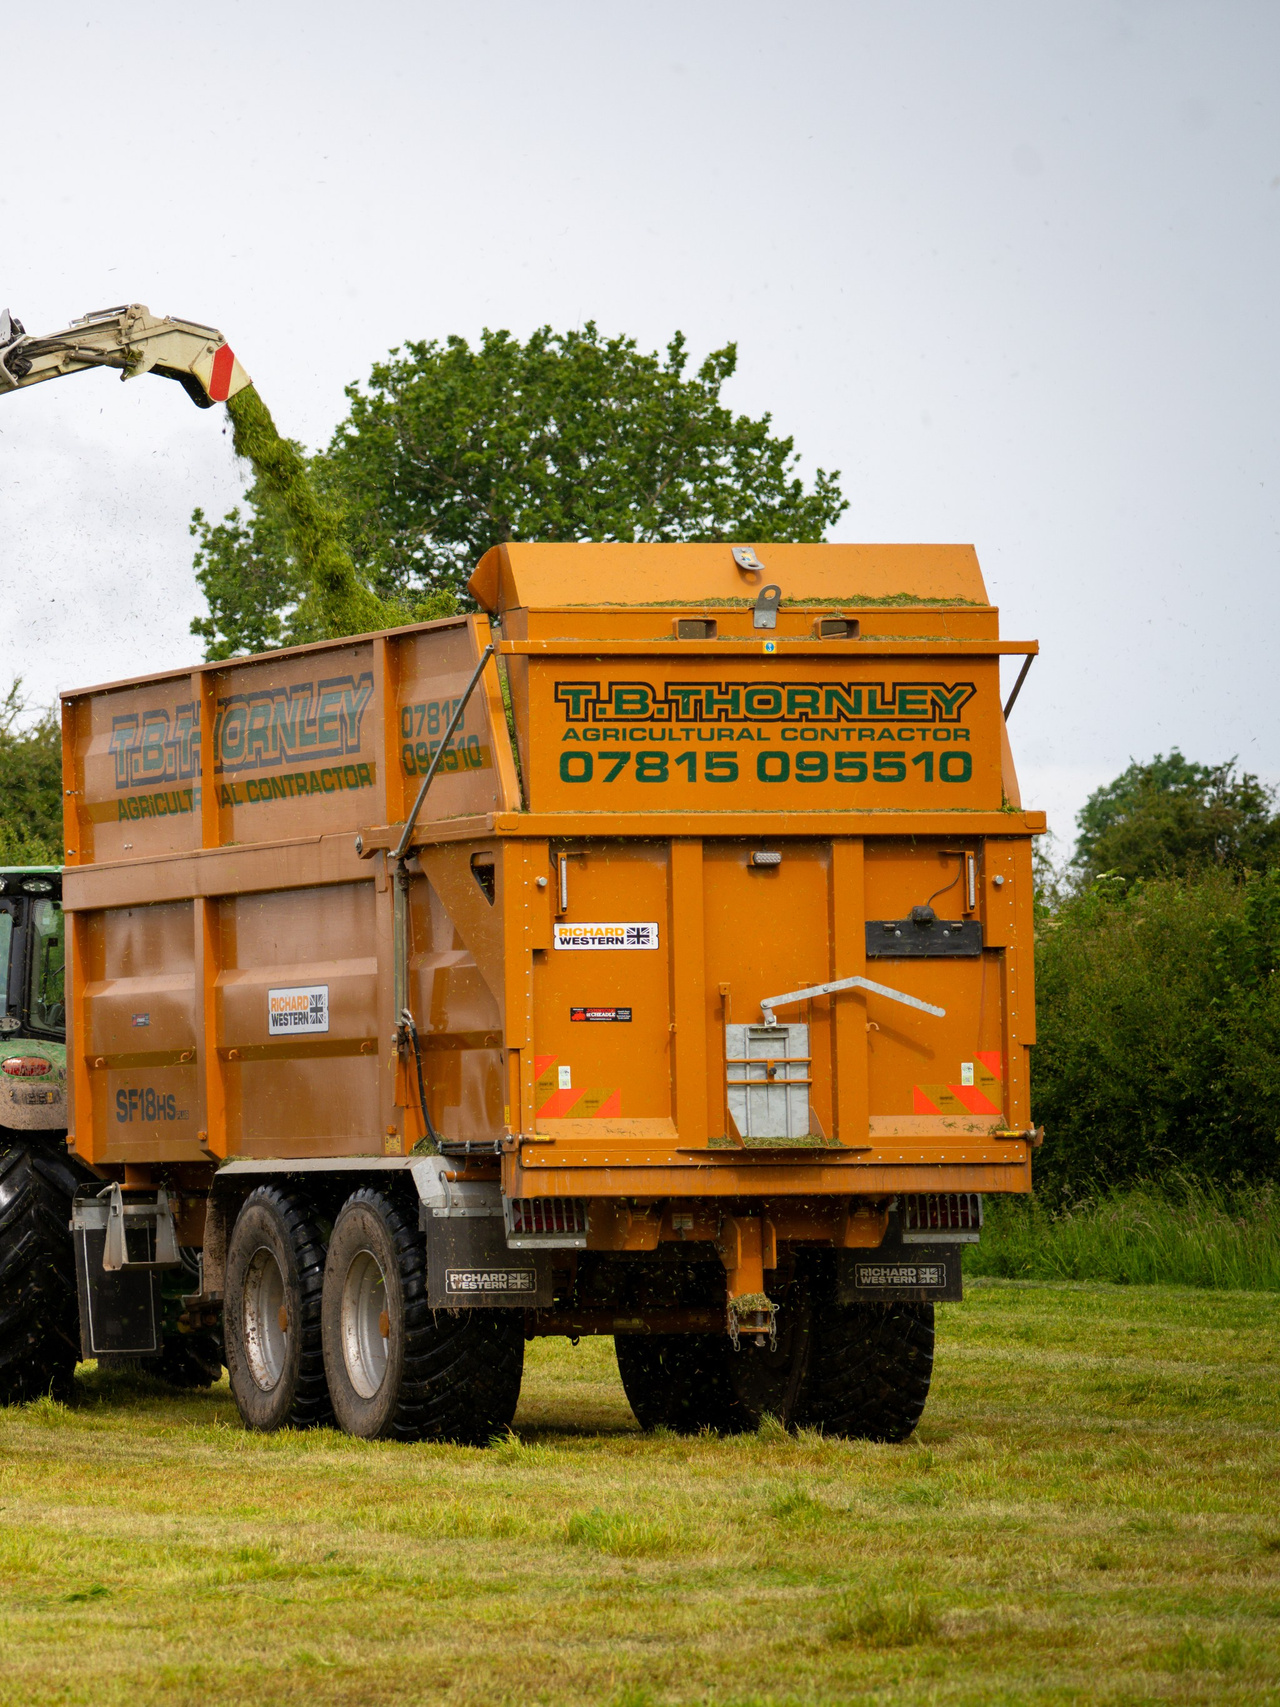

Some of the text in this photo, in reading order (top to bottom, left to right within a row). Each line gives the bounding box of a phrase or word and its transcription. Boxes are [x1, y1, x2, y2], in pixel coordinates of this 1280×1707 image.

[554, 681, 977, 722] T.B.THORNLEY
[562, 727, 970, 742] AGRICULTURAL CONTRACTOR
[559, 751, 973, 783] 07815 095510
[246, 762, 373, 806] CONTRACTOR
[559, 927, 625, 937] RICHARD
[560, 937, 625, 945] WESTERN
[271, 995, 309, 1012] RICHARD
[271, 1011, 309, 1027] WESTERN
[450, 1273, 508, 1282] RICHARD
[860, 1267, 917, 1276] RICHARD
[861, 1276, 916, 1284] WESTERN
